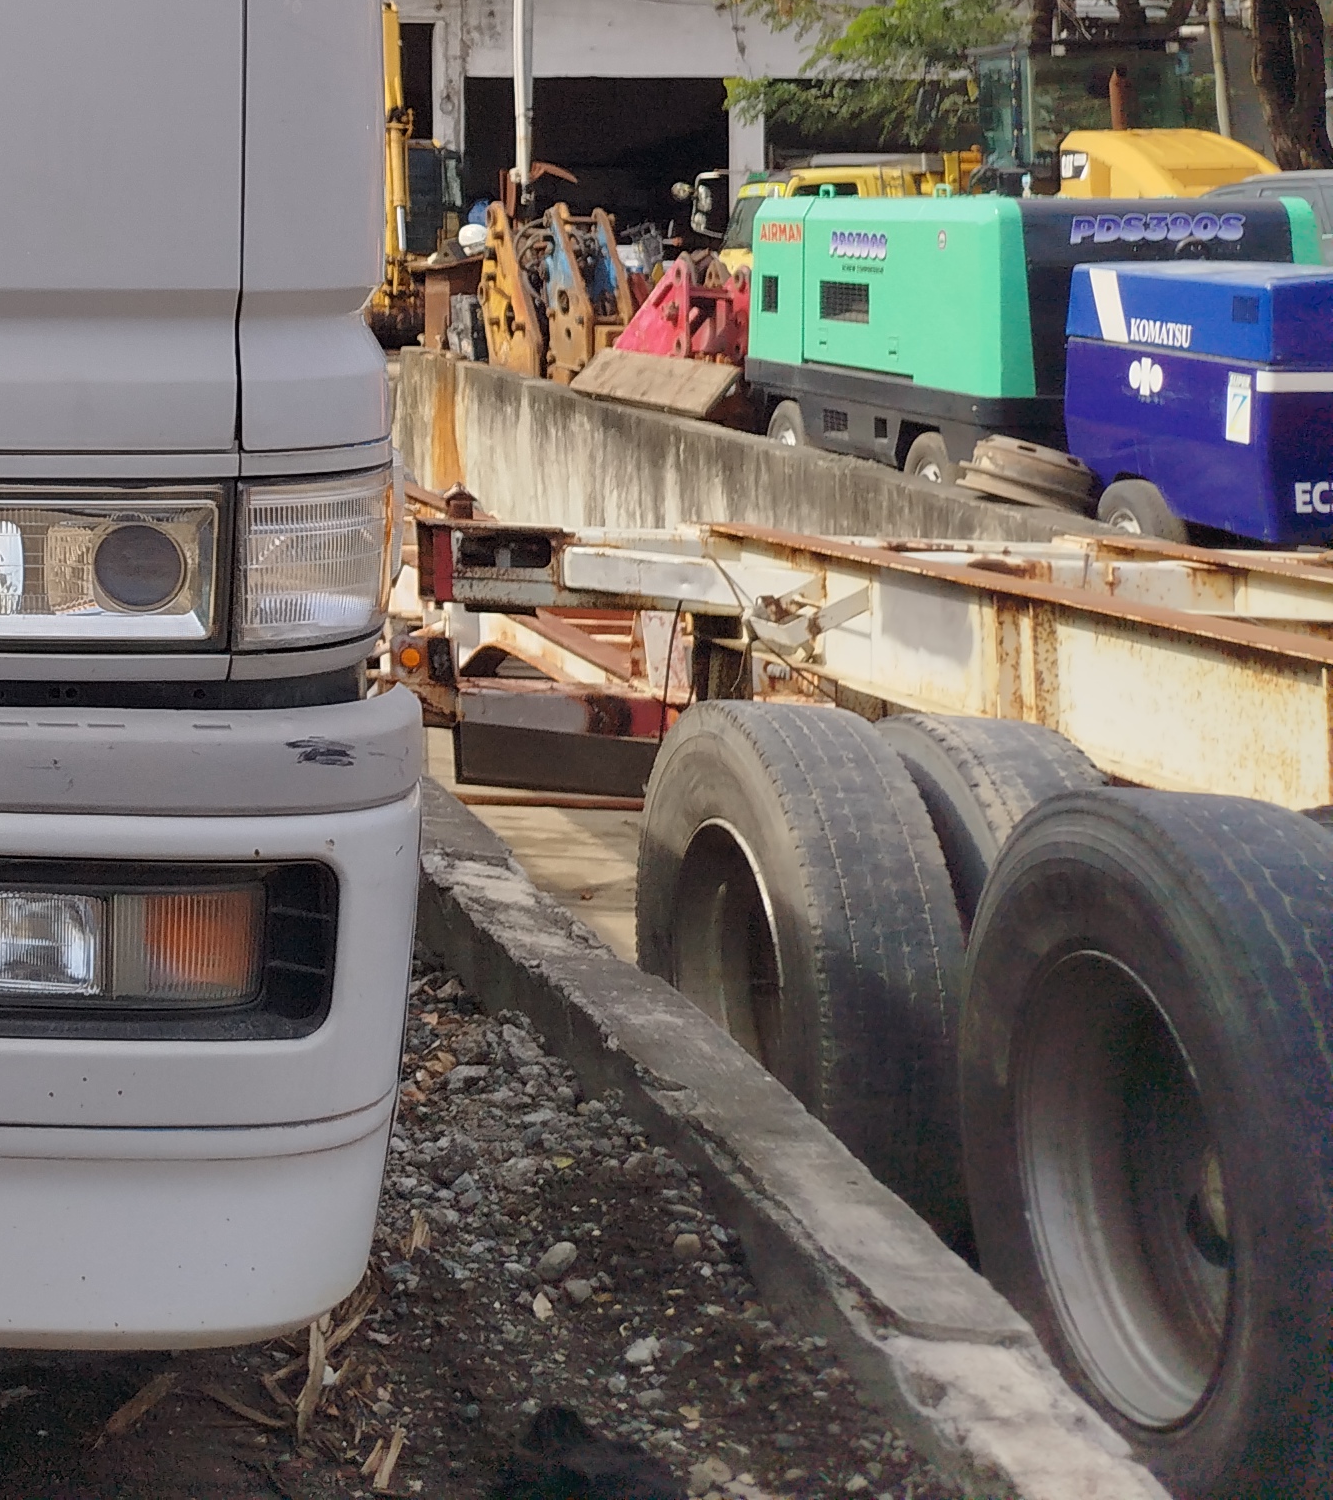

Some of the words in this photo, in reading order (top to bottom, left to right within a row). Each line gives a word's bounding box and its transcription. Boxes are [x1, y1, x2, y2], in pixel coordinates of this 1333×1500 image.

[760, 222, 802, 244] AIRMAN
[1069, 212, 1246, 245] PDS390S
[1130, 318, 1192, 348] KOMATSU
[1294, 481, 1333, 514] EC
